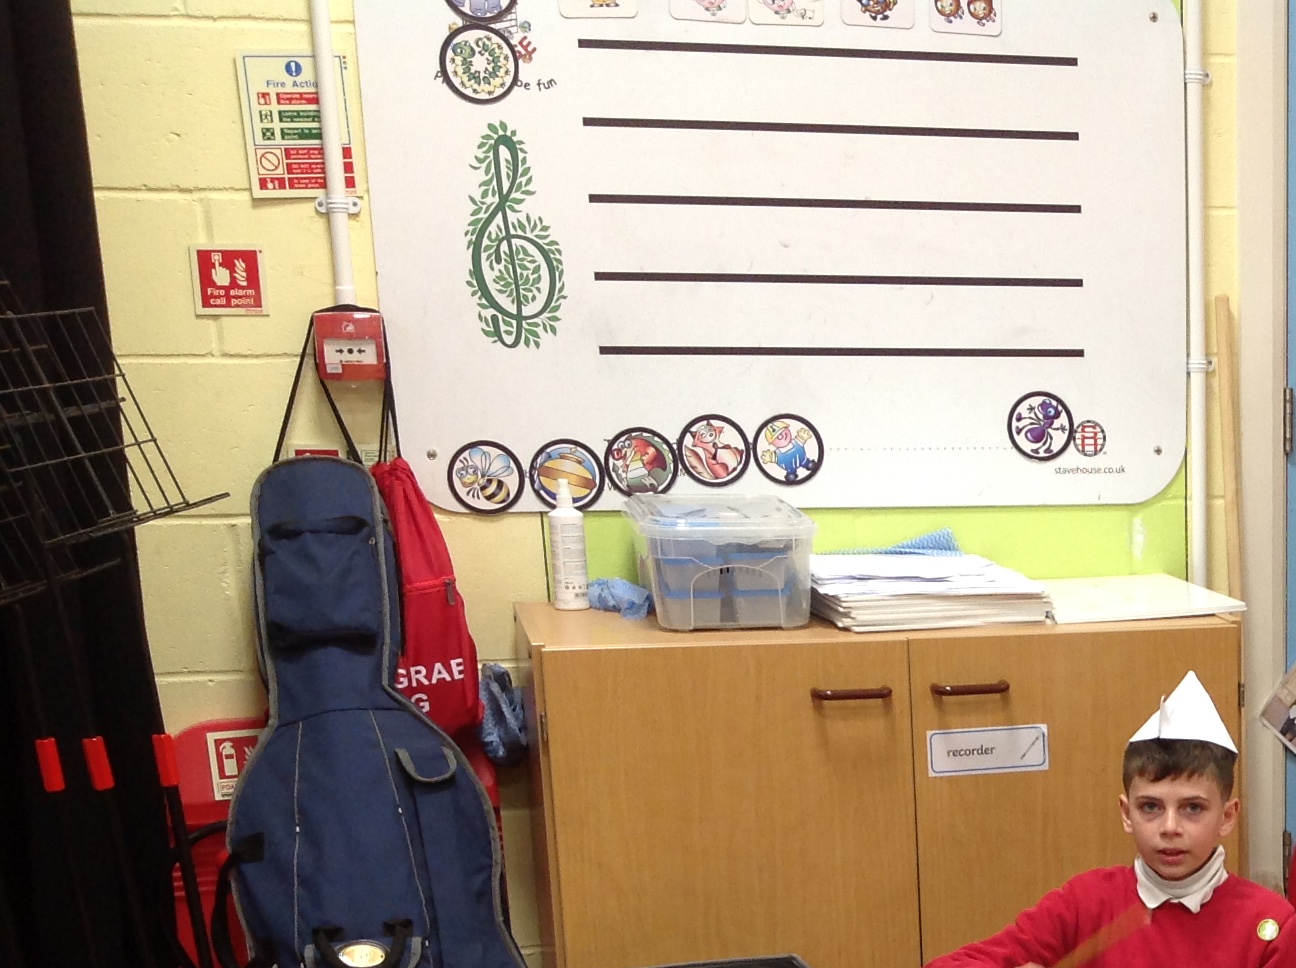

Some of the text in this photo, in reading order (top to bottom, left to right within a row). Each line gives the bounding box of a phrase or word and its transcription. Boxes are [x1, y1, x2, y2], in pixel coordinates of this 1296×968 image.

[266, 80, 318, 88] Fire Actio
[536, 78, 557, 92] fun
[232, 298, 254, 307] point
[1054, 465, 1126, 475] stavehouse.co.uk
[946, 744, 996, 758] recorder
